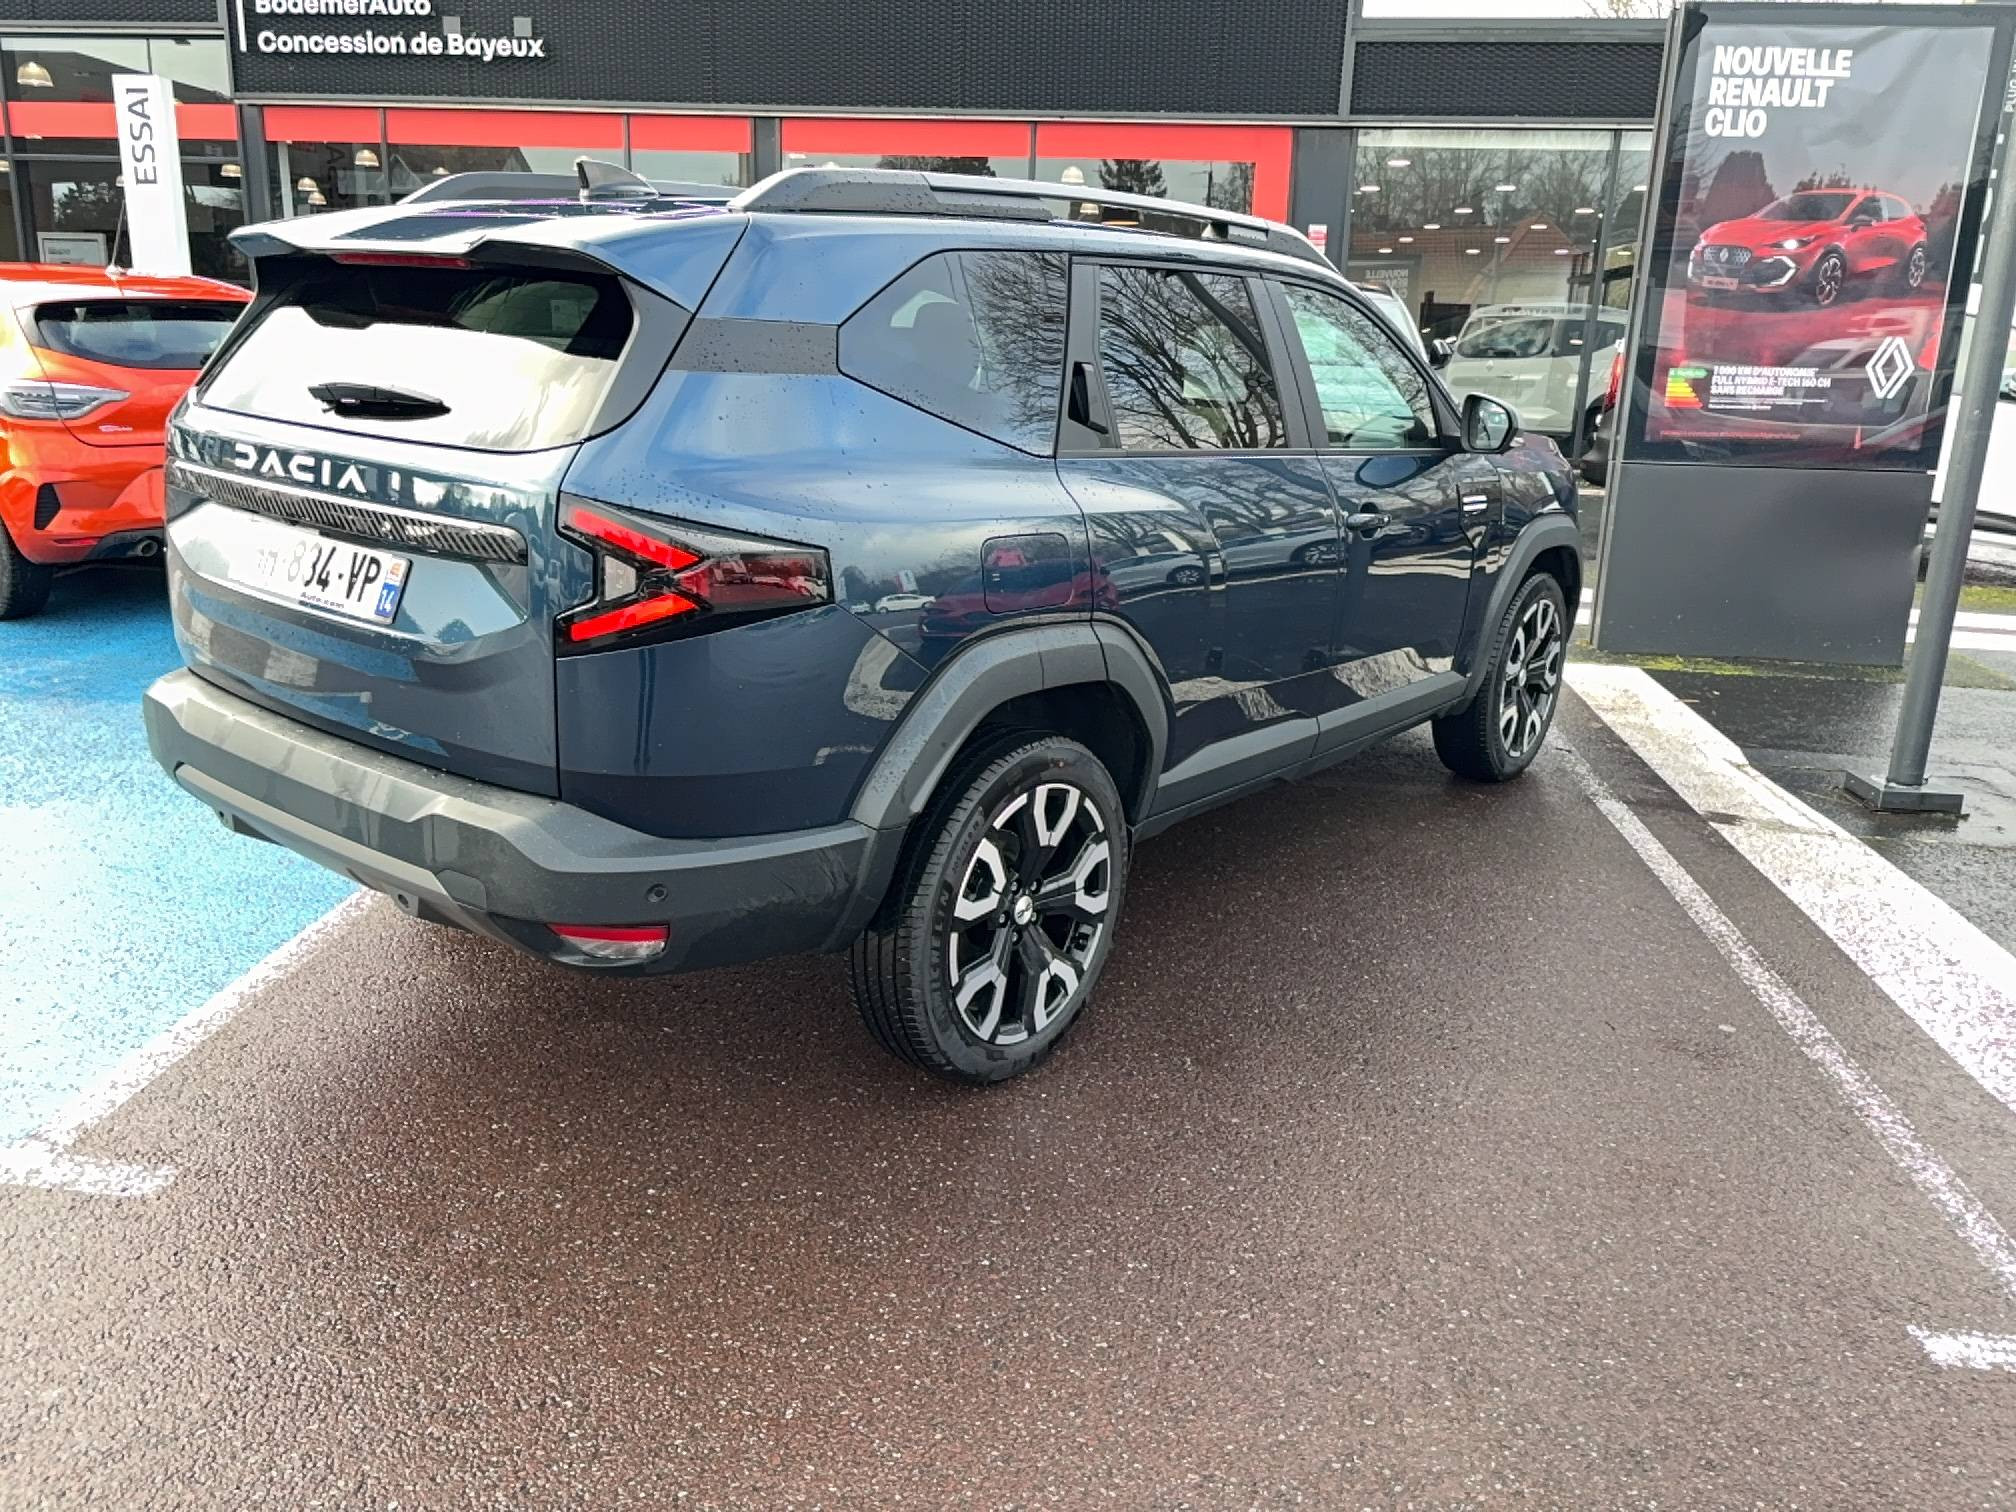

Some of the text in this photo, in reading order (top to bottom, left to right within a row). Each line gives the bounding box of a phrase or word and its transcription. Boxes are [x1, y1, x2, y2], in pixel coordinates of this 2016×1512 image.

[257, 31, 545, 61] Concession de Bayeux
[1713, 45, 1853, 77] NOUVELLE
[1708, 76, 1834, 107] RENAULT
[126, 88, 157, 185] ESSAI
[1705, 107, 1767, 137] CLIO
[1710, 385, 1785, 396] SANS RECHARGE
[1711, 375, 1733, 385] FULL
[1734, 376, 1768, 386] HYBRID
[1768, 377, 1801, 387] E-TECH
[234, 443, 367, 493] DACIA
[379, 588, 395, 612] 14
